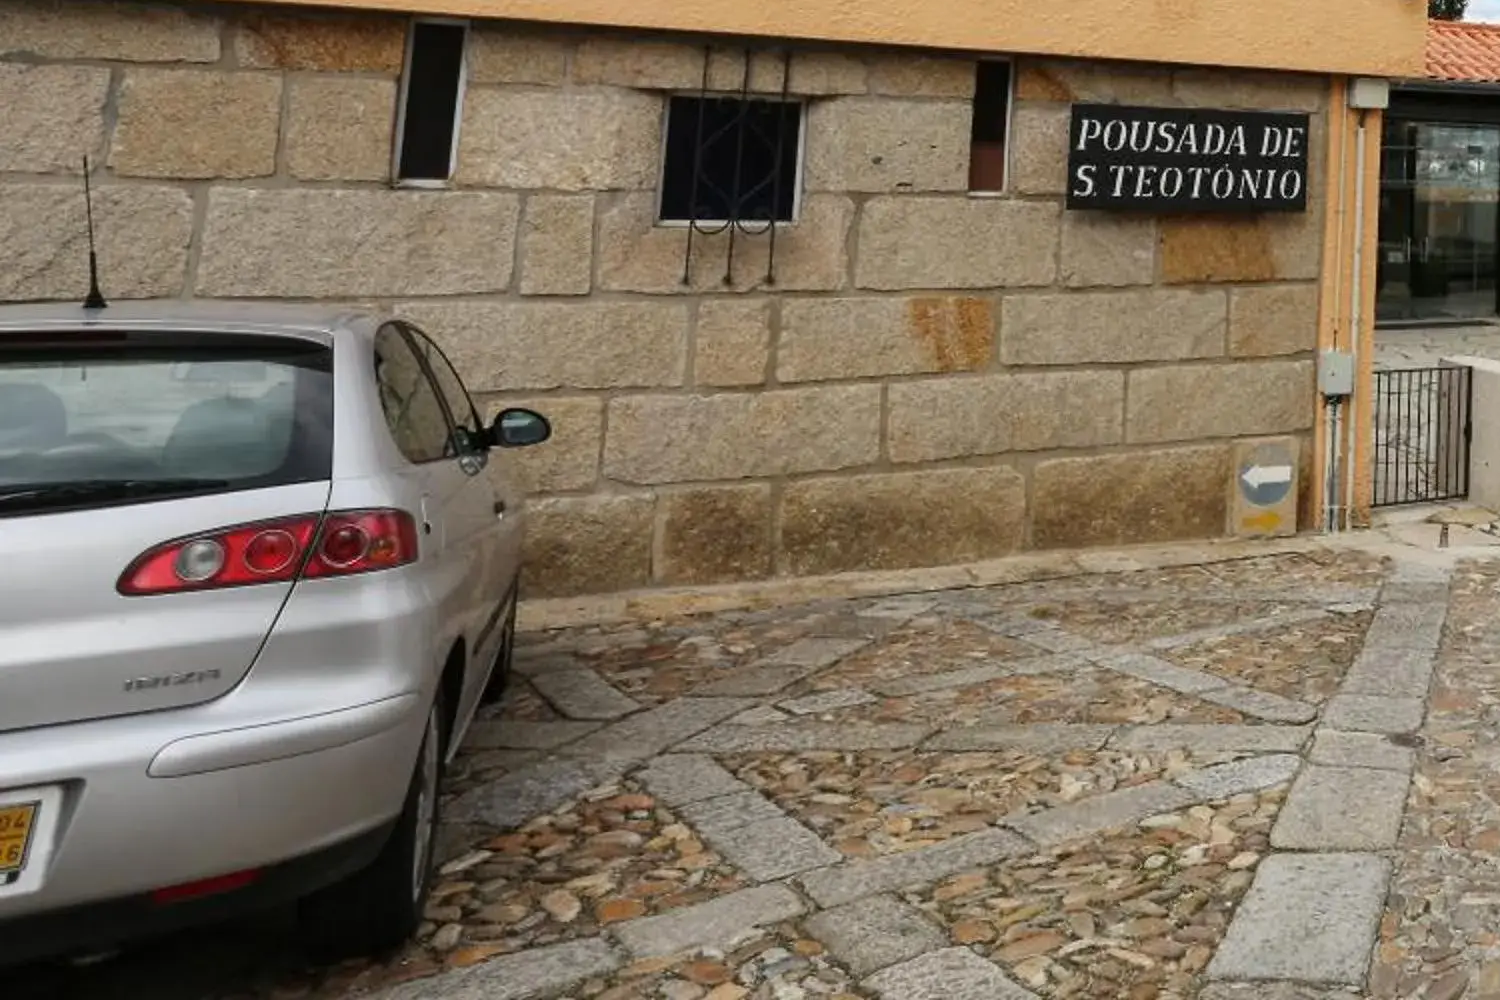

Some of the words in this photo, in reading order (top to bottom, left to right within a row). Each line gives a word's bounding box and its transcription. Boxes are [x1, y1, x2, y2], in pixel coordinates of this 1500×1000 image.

[1076, 119, 1248, 156] POUSADA
[1259, 126, 1304, 157] DE
[1109, 163, 1301, 199] TEOTÓNIO
